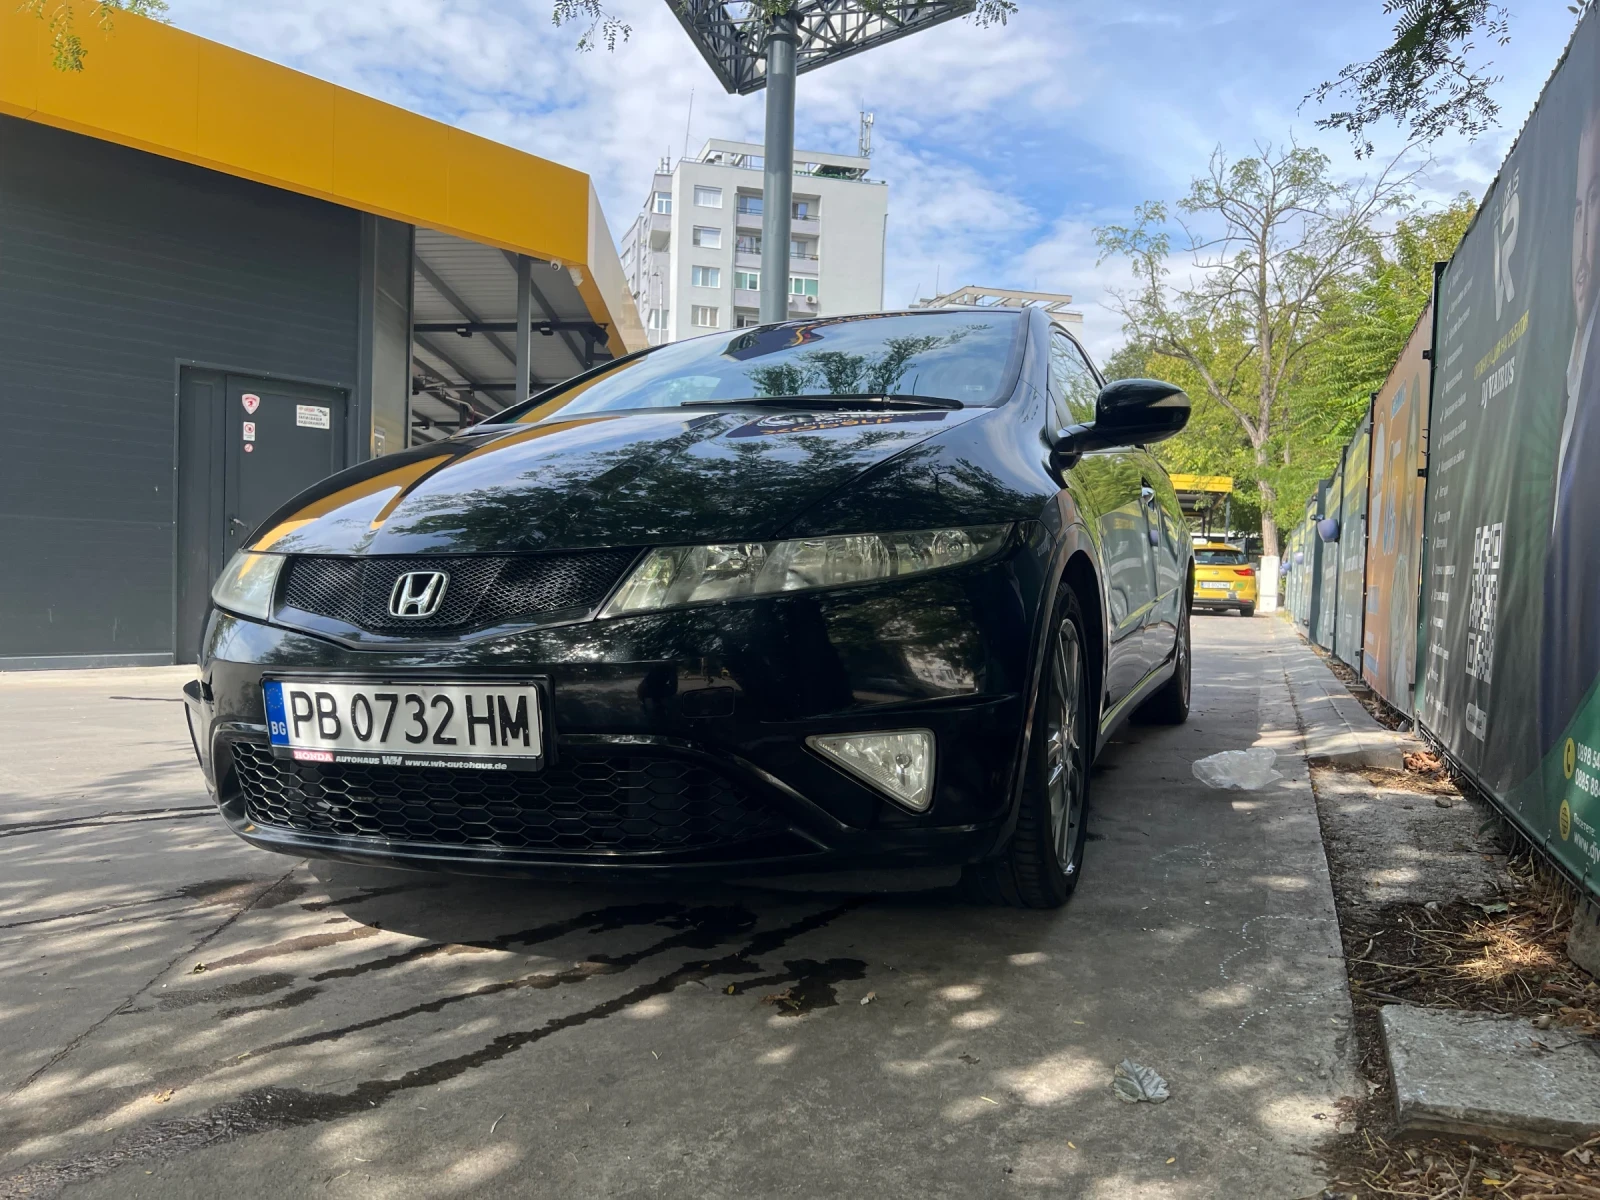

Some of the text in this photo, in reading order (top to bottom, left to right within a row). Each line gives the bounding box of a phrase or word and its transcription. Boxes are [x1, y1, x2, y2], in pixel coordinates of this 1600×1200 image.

[1488, 356, 1516, 400] VAIRUS
[270, 721, 287, 736] BG
[290, 691, 530, 747] PB 0732 HM
[294, 751, 333, 762] HONDA
[335, 756, 380, 765] AUTOHAUS
[405, 760, 508, 770] www.wh-autohaus.de
[1590, 777, 1600, 798] 88
